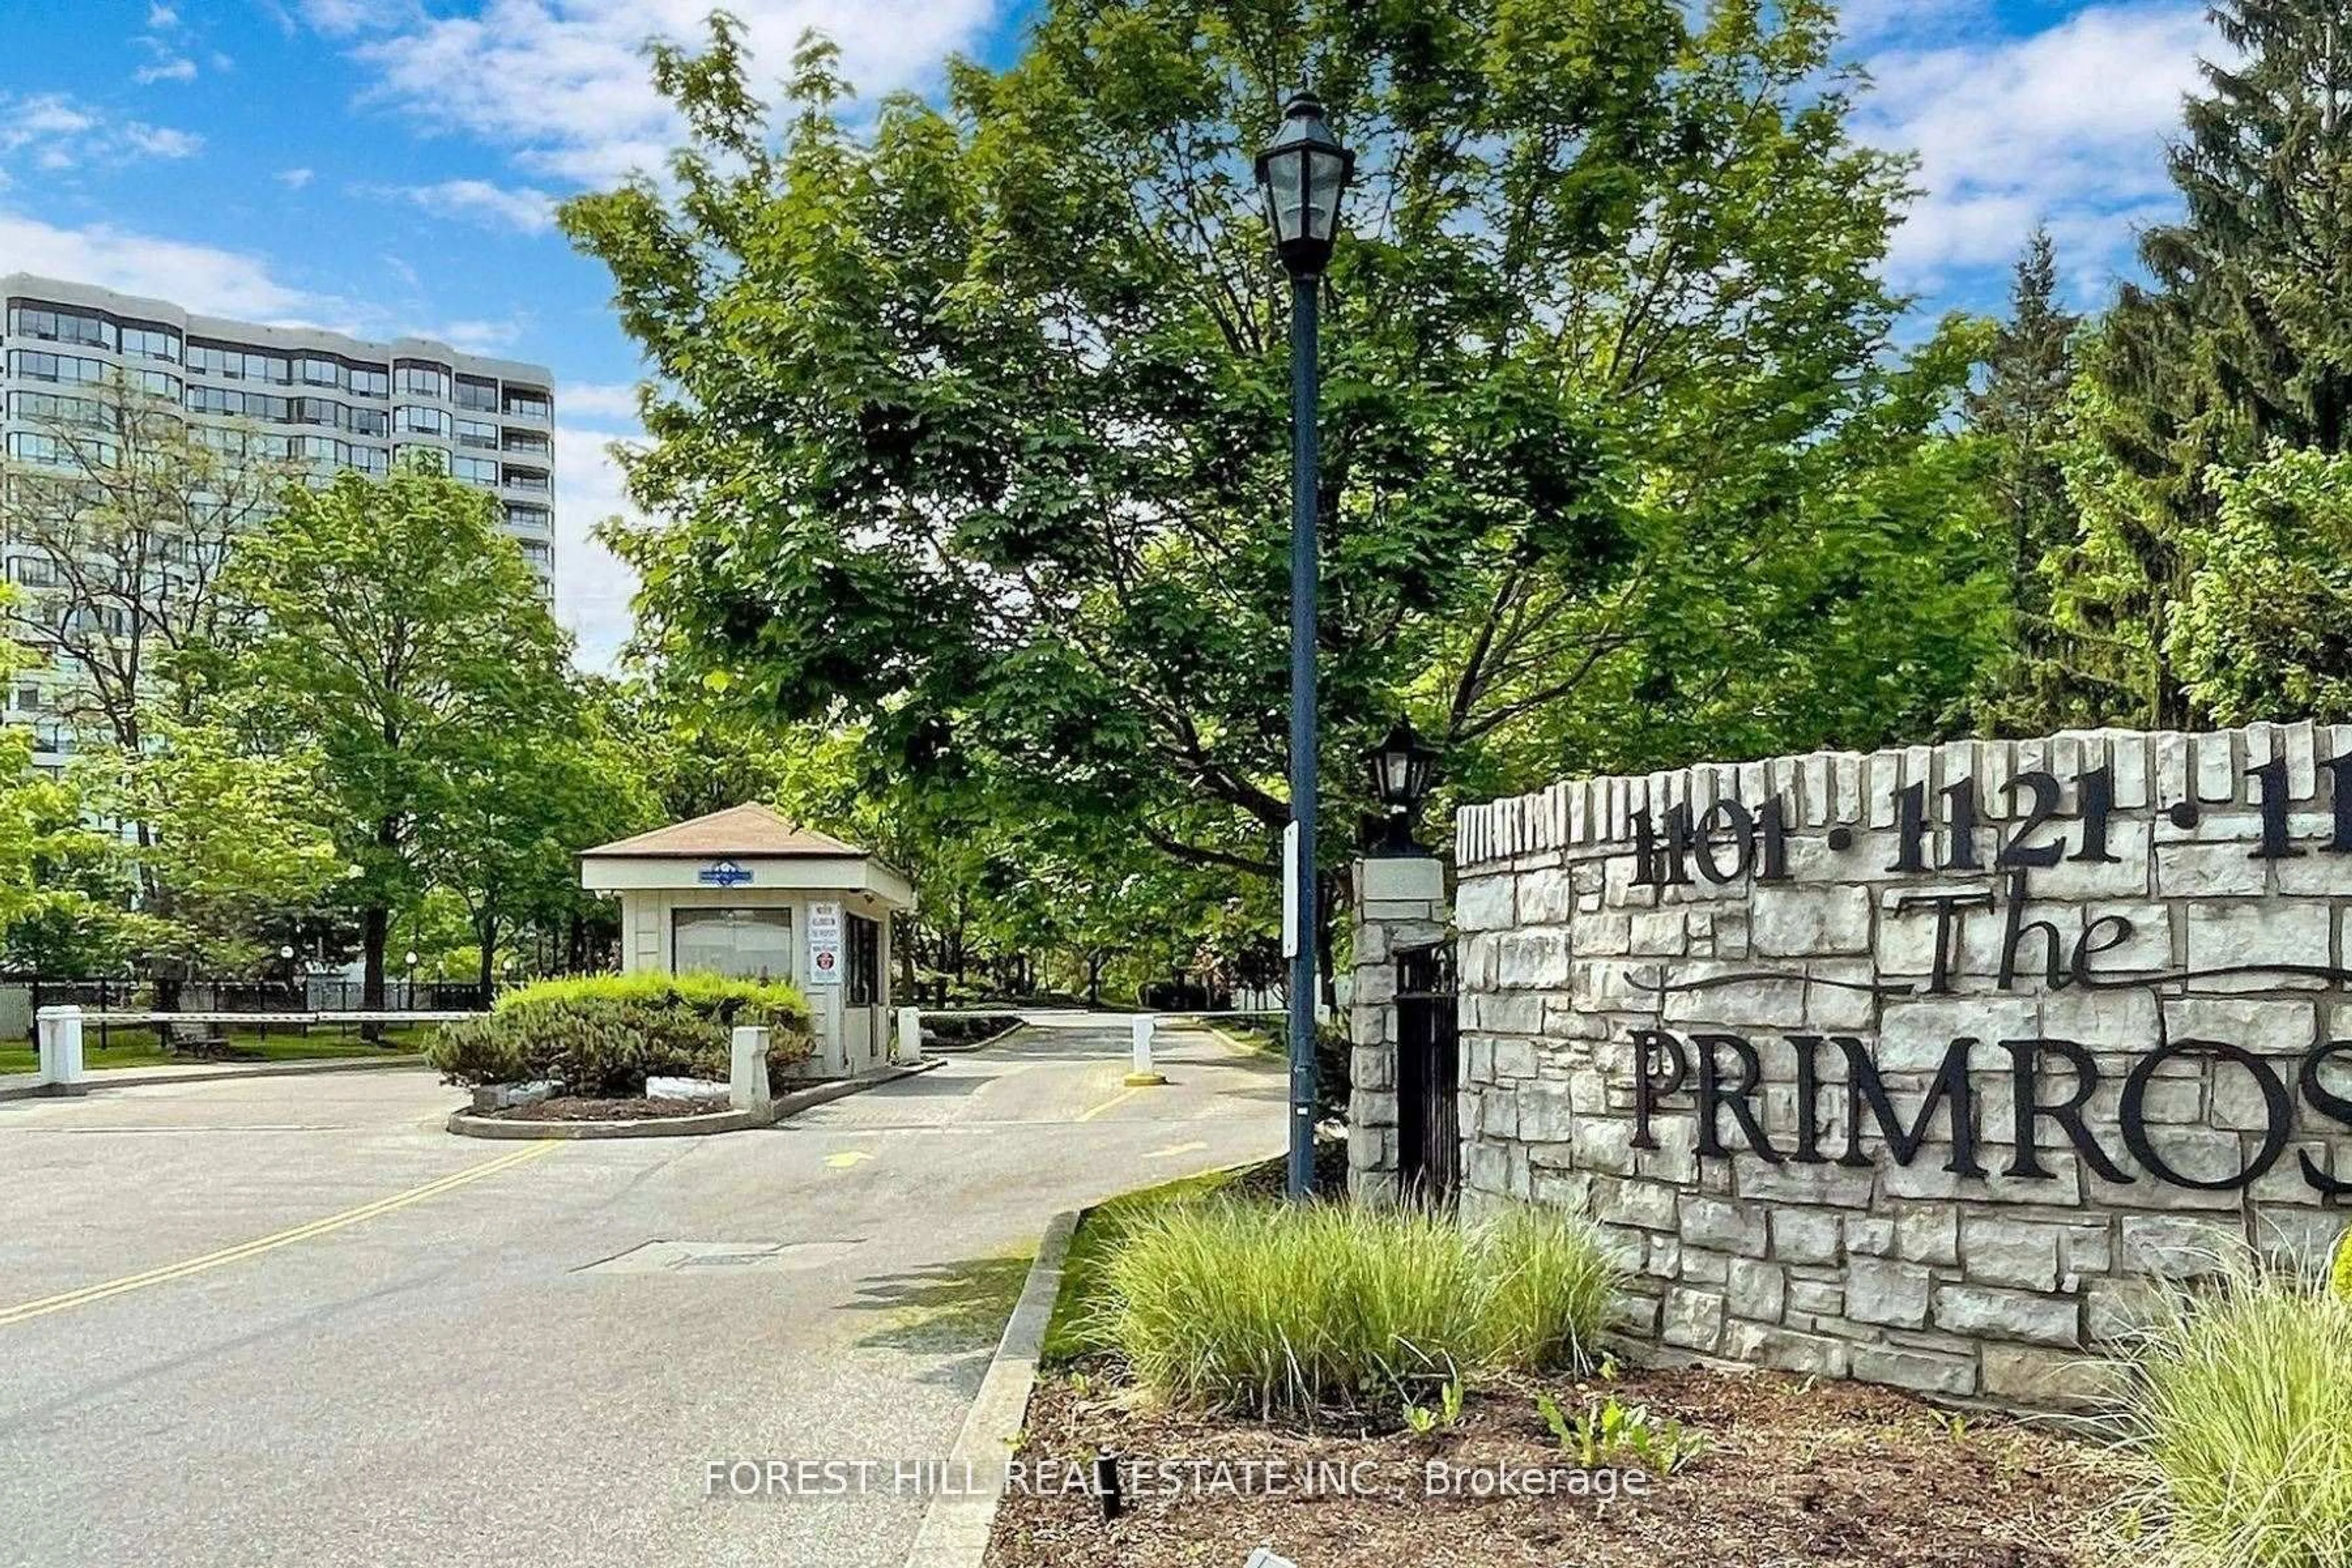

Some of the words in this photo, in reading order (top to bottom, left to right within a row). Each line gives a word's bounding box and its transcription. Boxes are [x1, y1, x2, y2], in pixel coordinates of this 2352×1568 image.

[1627, 793, 1795, 888] 1101
[1884, 764, 2122, 872] 1121
[1893, 866, 2133, 994] The
